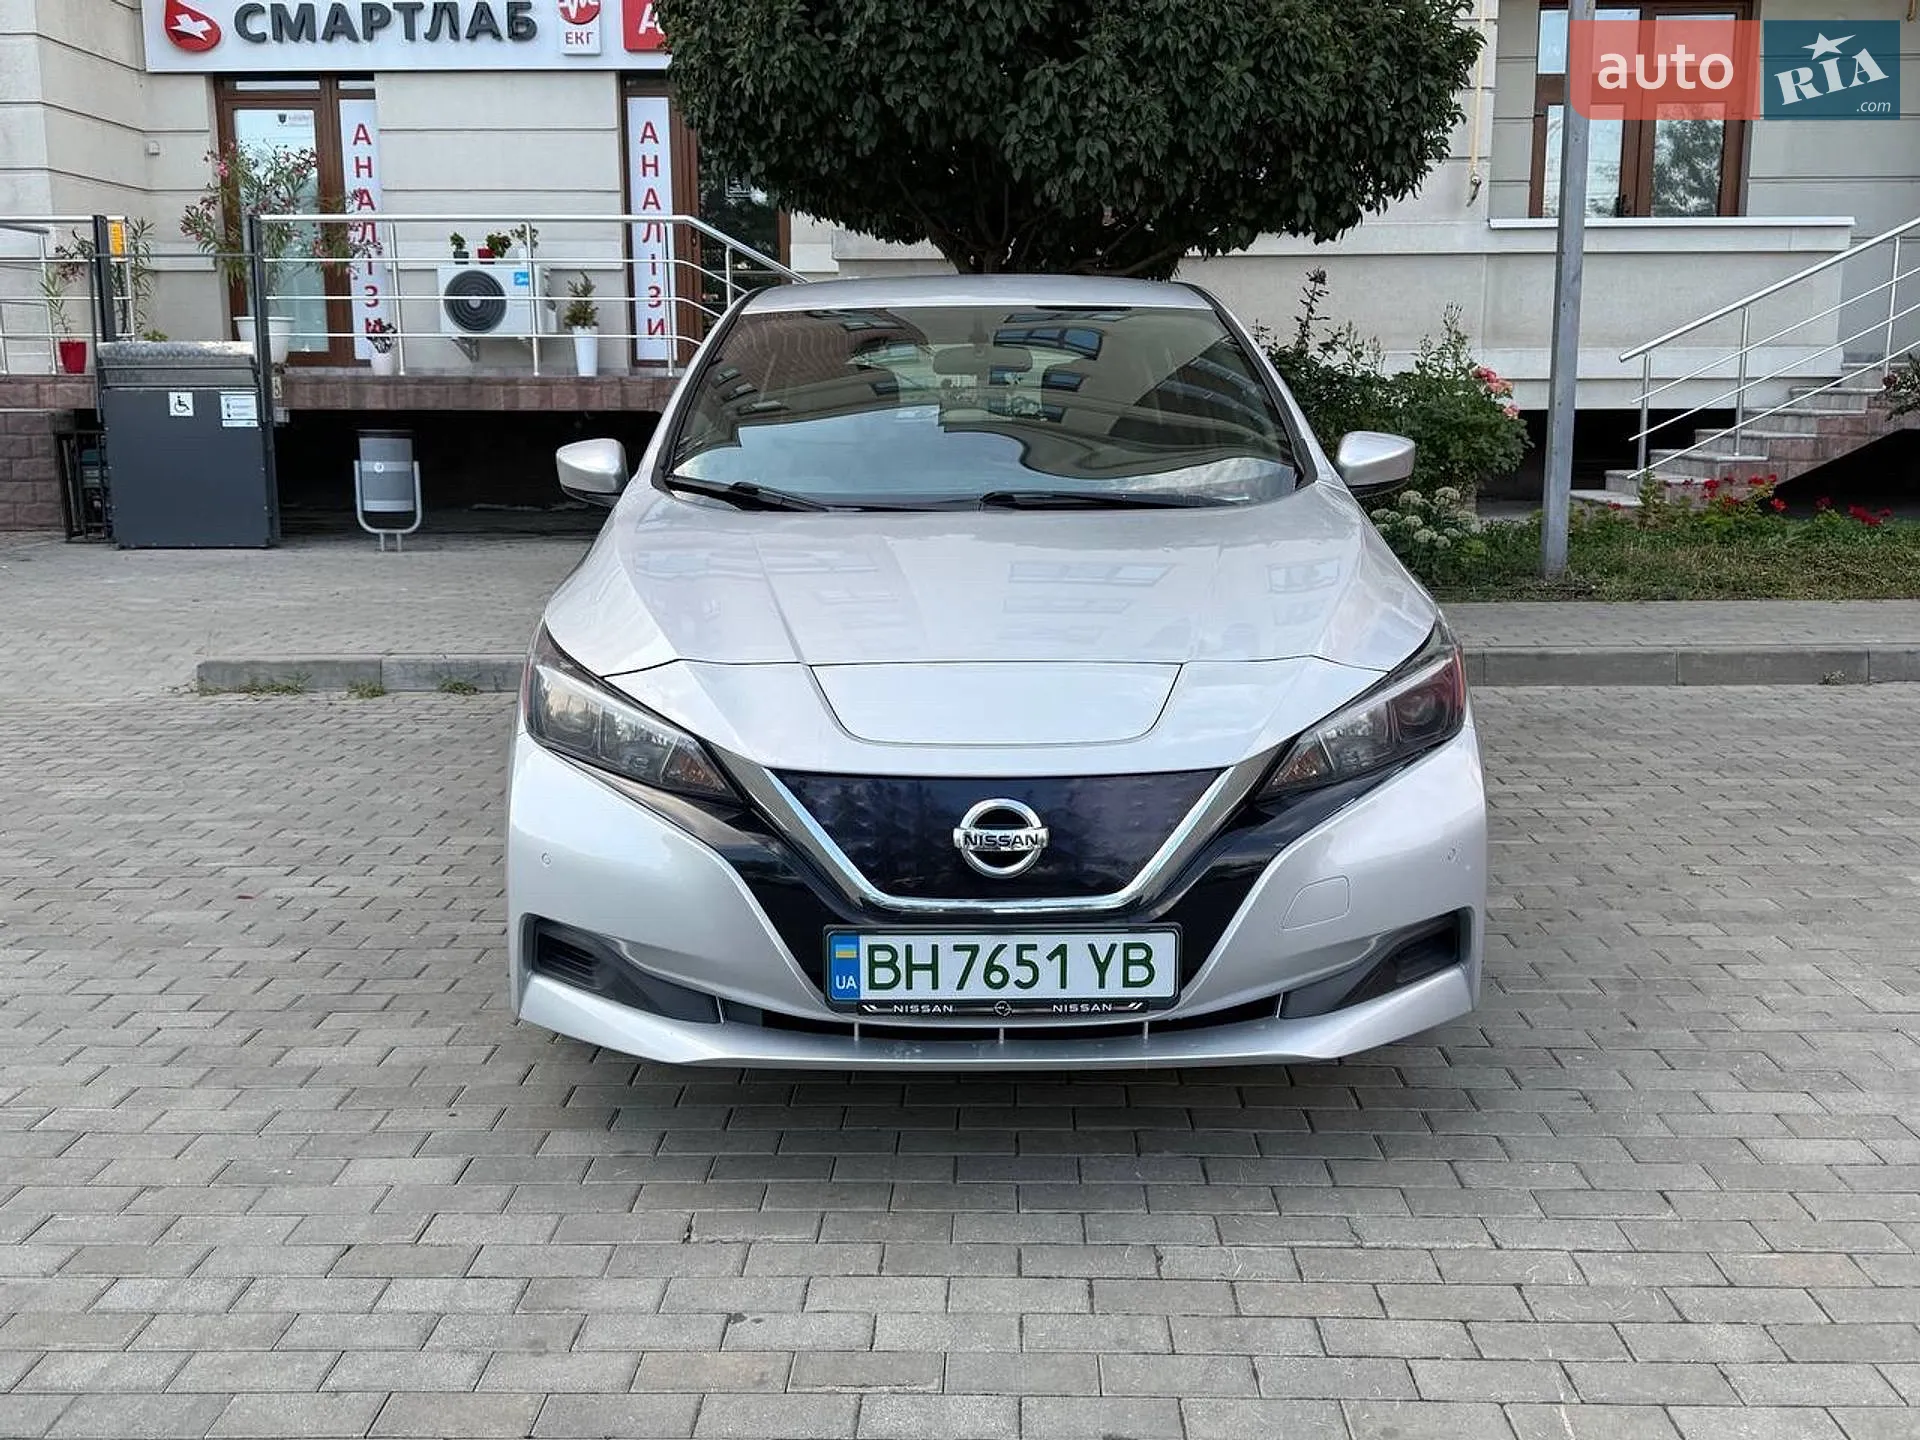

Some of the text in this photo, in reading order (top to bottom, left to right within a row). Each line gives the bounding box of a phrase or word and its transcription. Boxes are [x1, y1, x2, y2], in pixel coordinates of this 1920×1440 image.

[233, 1, 538, 43] СМАРТЛАБ
[565, 31, 595, 45] ЕКГ
[639, 121, 667, 340] АНАЛІЗИ
[963, 833, 1039, 847] NISSAN
[867, 942, 1156, 991] BH 7651 YB
[835, 974, 857, 990] UA
[893, 1003, 1112, 1013] NISSAN NISSAN
